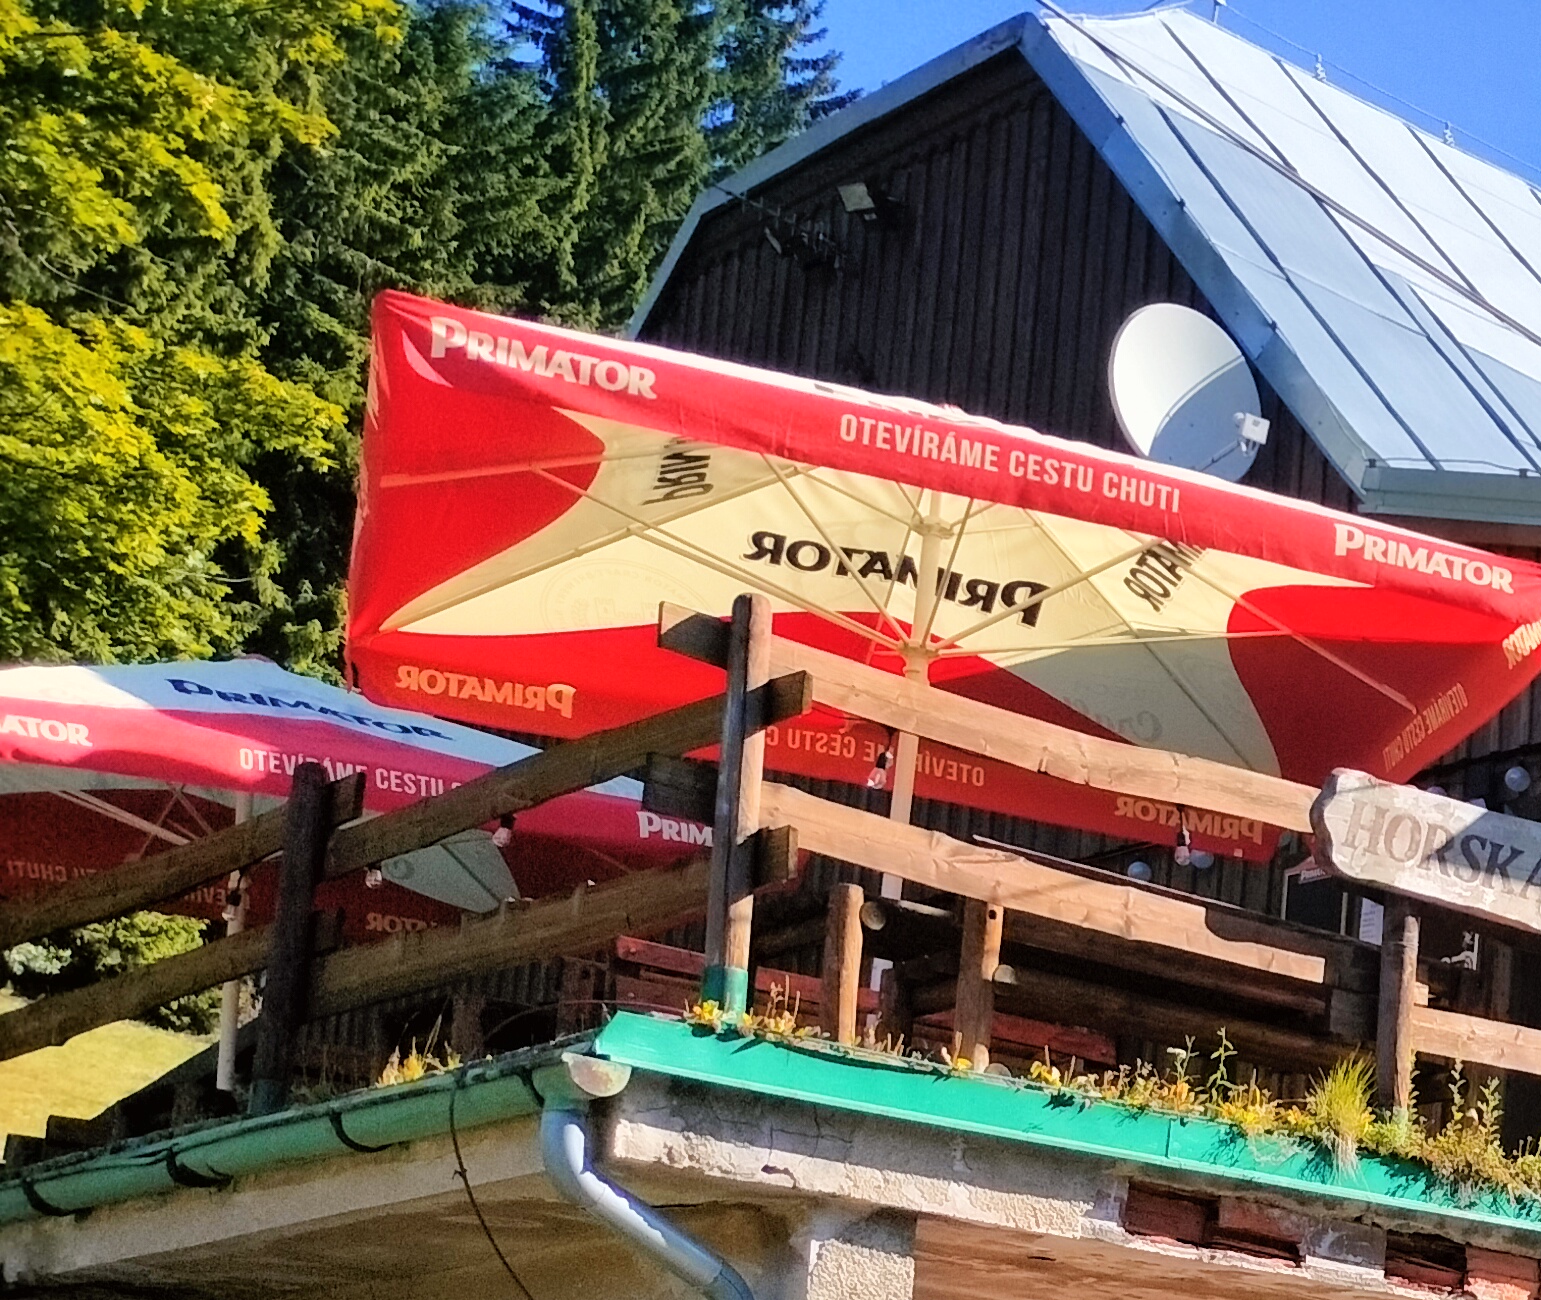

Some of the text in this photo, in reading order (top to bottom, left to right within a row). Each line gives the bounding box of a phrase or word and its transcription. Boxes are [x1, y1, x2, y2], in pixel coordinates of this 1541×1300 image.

[429, 315, 657, 400] PRIMATOR
[839, 413, 1180, 513] OTEVÍRÁME CESTU CHUTI
[1333, 523, 1514, 594] PRIMATOR
[0, 714, 93, 747] ATOR
[636, 811, 714, 847] PRIM
